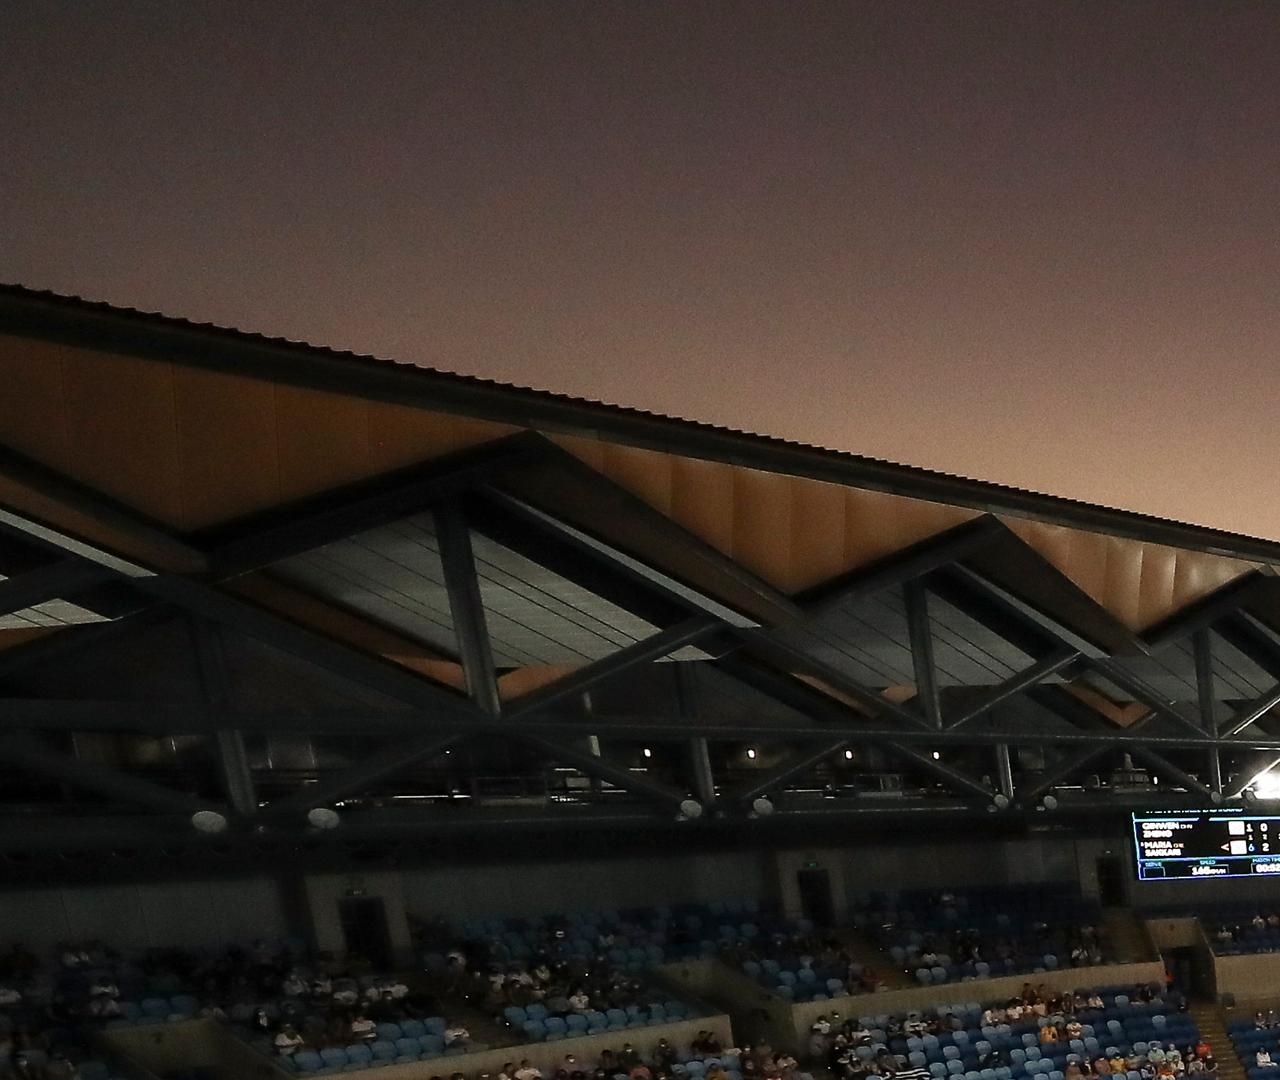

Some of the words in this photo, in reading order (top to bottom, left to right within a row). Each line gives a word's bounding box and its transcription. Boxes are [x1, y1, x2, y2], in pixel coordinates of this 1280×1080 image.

[1246, 823, 1253, 832] 1
[1260, 822, 1268, 832] 0
[1248, 843, 1255, 852] 6
[1262, 842, 1269, 852] 2
